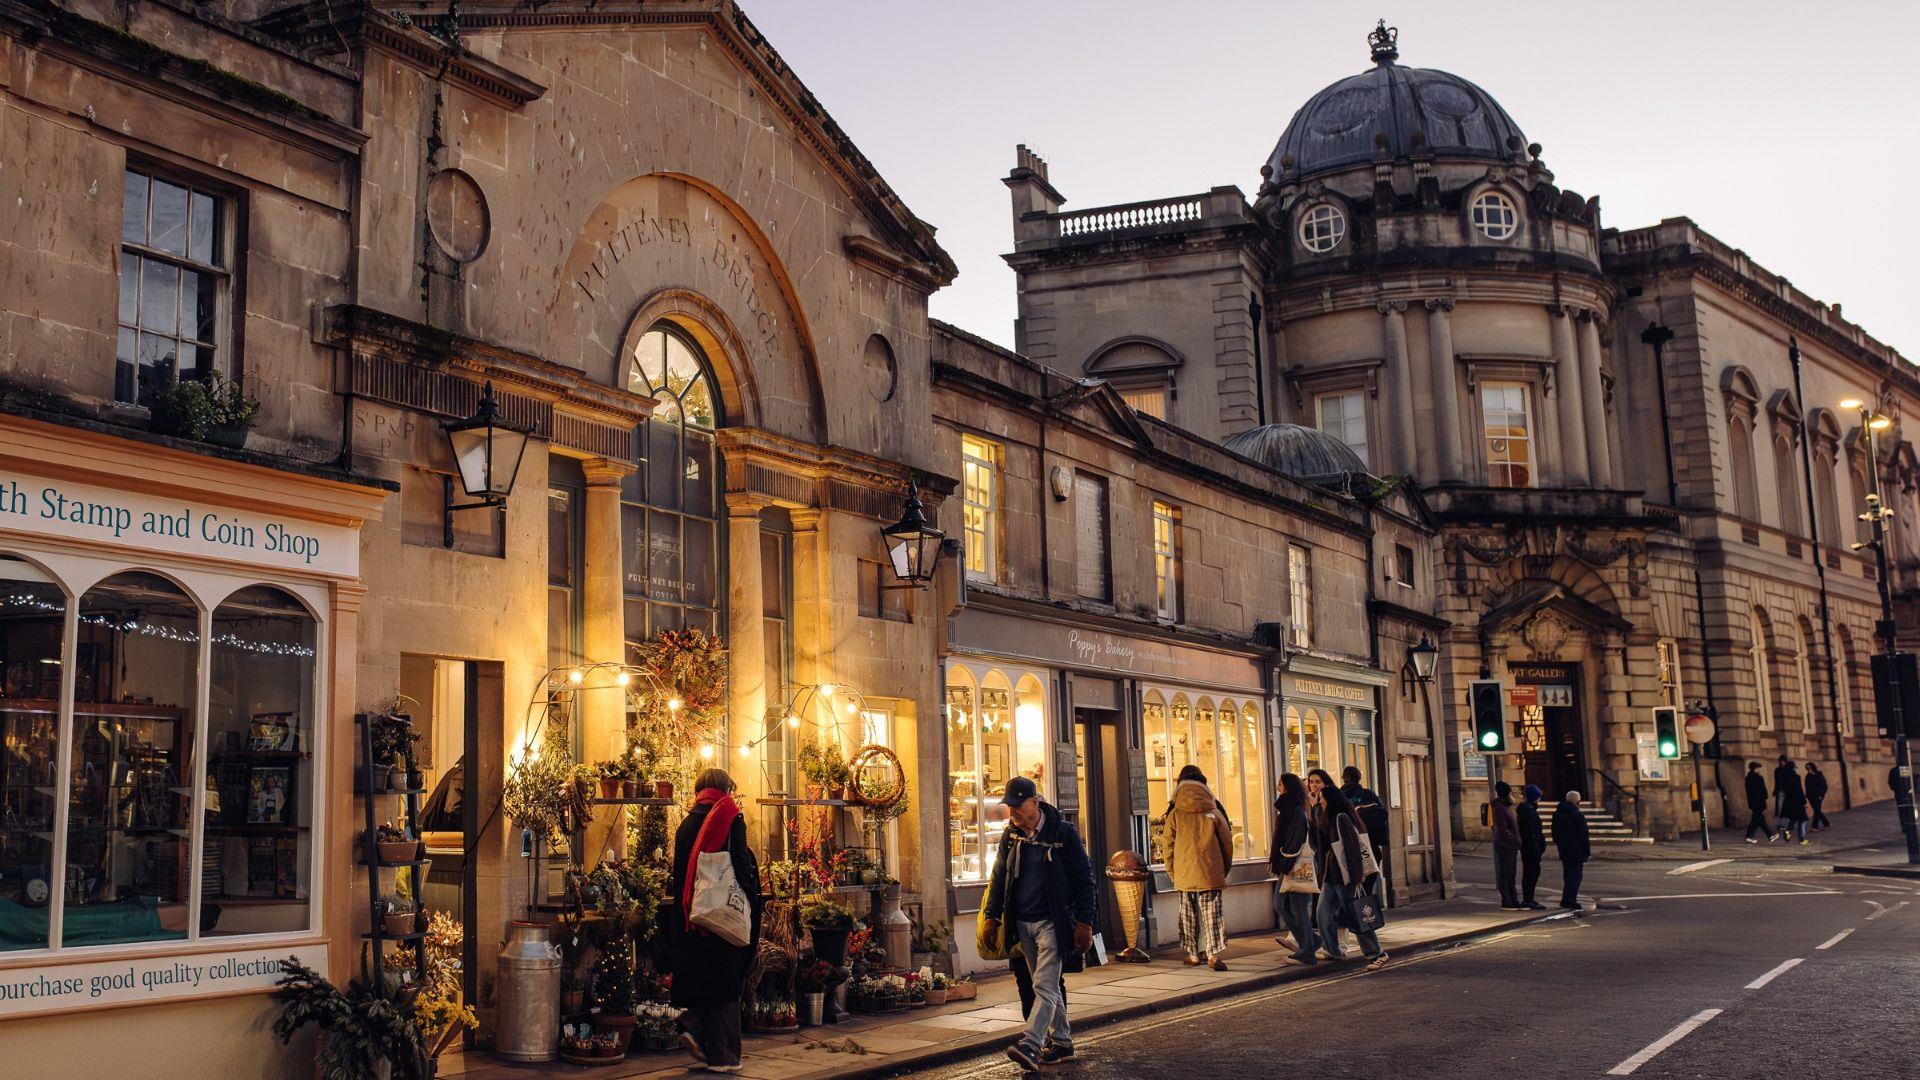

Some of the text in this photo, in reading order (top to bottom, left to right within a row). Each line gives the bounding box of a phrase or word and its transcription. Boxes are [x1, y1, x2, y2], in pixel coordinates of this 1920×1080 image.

[576, 218, 780, 358] PULTENEY BRIDGE
[40, 488, 131, 537] Stamp
[142, 509, 190, 539] and
[201, 514, 255, 548] Coin
[264, 524, 320, 564] Shop
[628, 573, 697, 592] PULTNEY BRIGE
[1068, 629, 1102, 663] Poppy's
[1105, 636, 1135, 669] Bakery
[1508, 668, 1566, 678] ART GALLERY
[1295, 679, 1365, 702] PULTENEY BRIDGE COFFEE
[90, 967, 135, 997] good
[142, 963, 203, 992] quality
